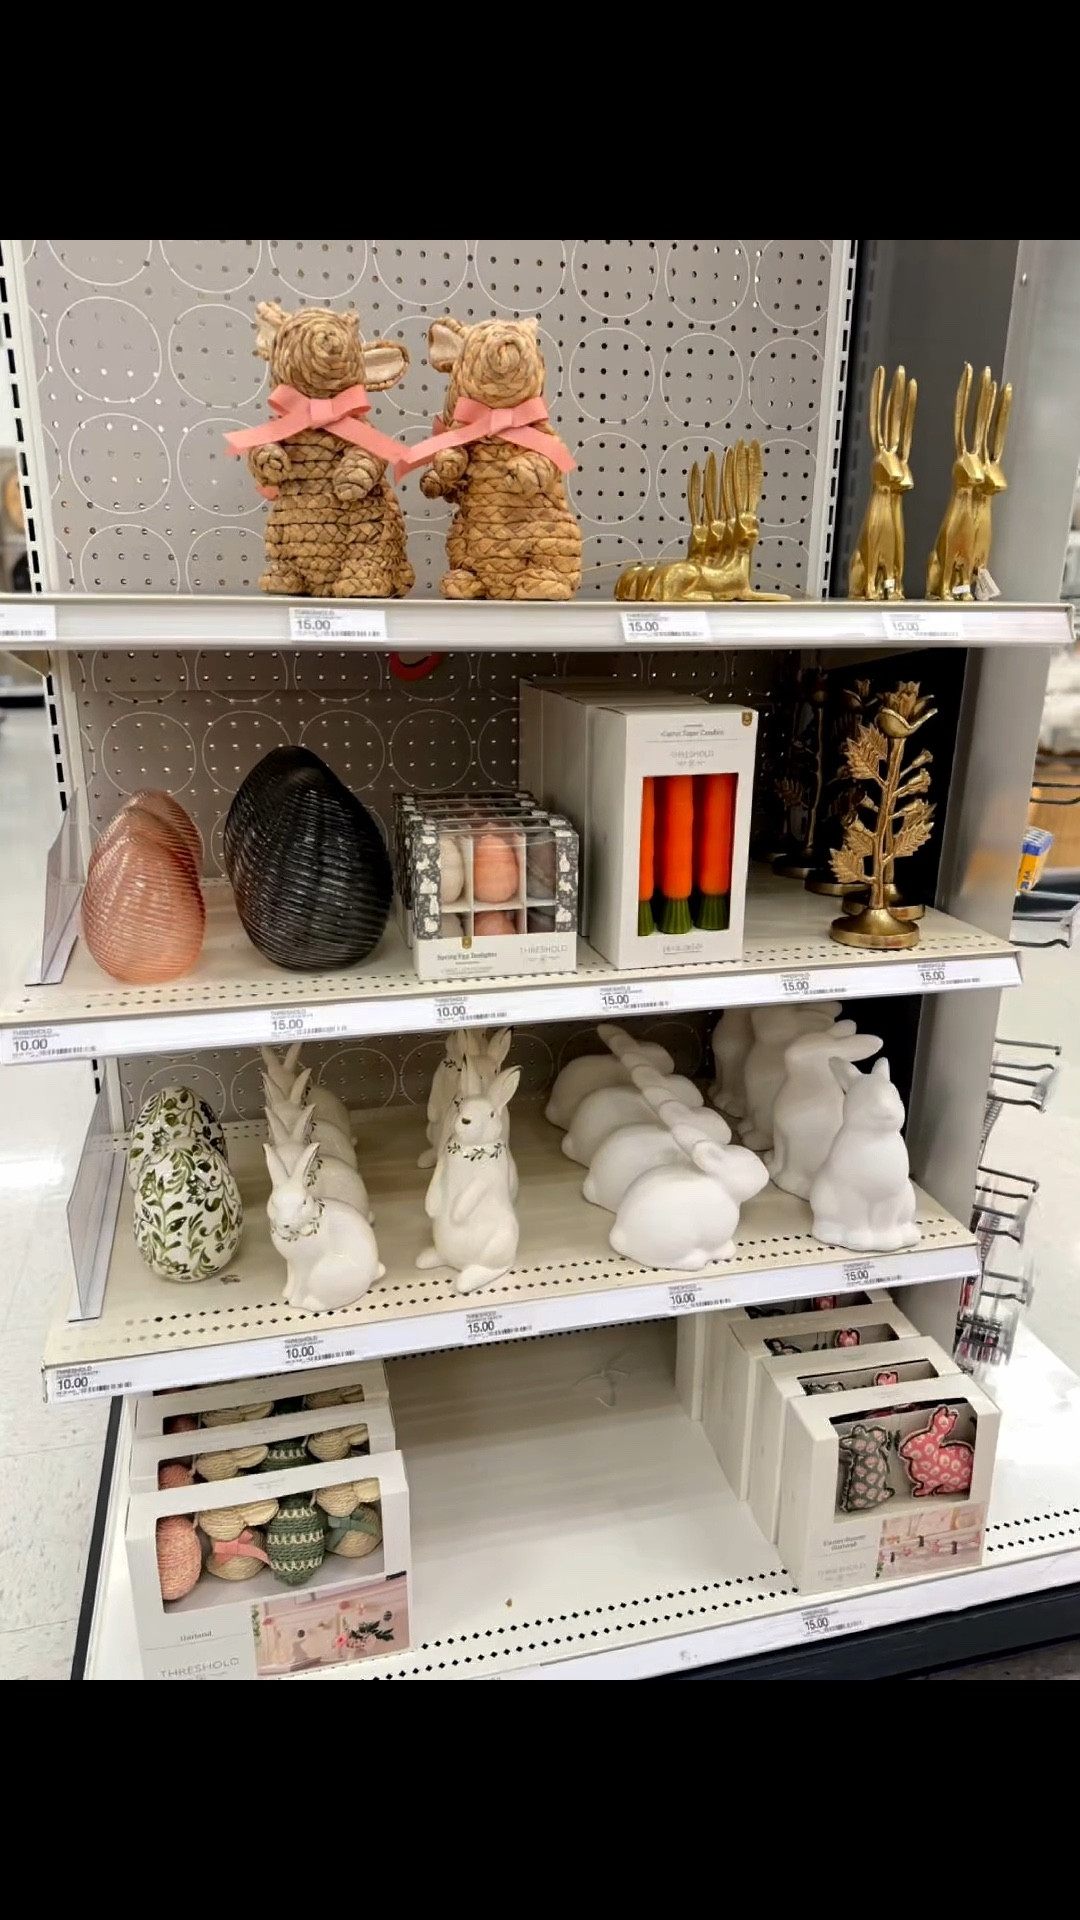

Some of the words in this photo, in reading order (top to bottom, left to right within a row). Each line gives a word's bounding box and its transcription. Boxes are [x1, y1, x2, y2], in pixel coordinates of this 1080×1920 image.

[297, 619, 331, 630] 15.00
[629, 621, 660, 632] 15.00
[520, 944, 568, 954] THRESHOLD
[920, 970, 945, 982] 15.00
[783, 980, 809, 992] 15.00
[602, 993, 629, 1006] 15.00
[436, 1005, 466, 1018] 10.00
[272, 1018, 303, 1031] 15.00
[14, 1038, 47, 1053] 10.00
[845, 1269, 869, 1282] 15.00
[671, 1292, 695, 1305] 10.00
[467, 1320, 494, 1334] 15.00
[286, 1345, 314, 1359] 10.00
[57, 1376, 88, 1391] 10.00
[805, 1616, 829, 1631] 15.00
[180, 1630, 214, 1642] Garland
[160, 1657, 240, 1678] THRESHOLD
